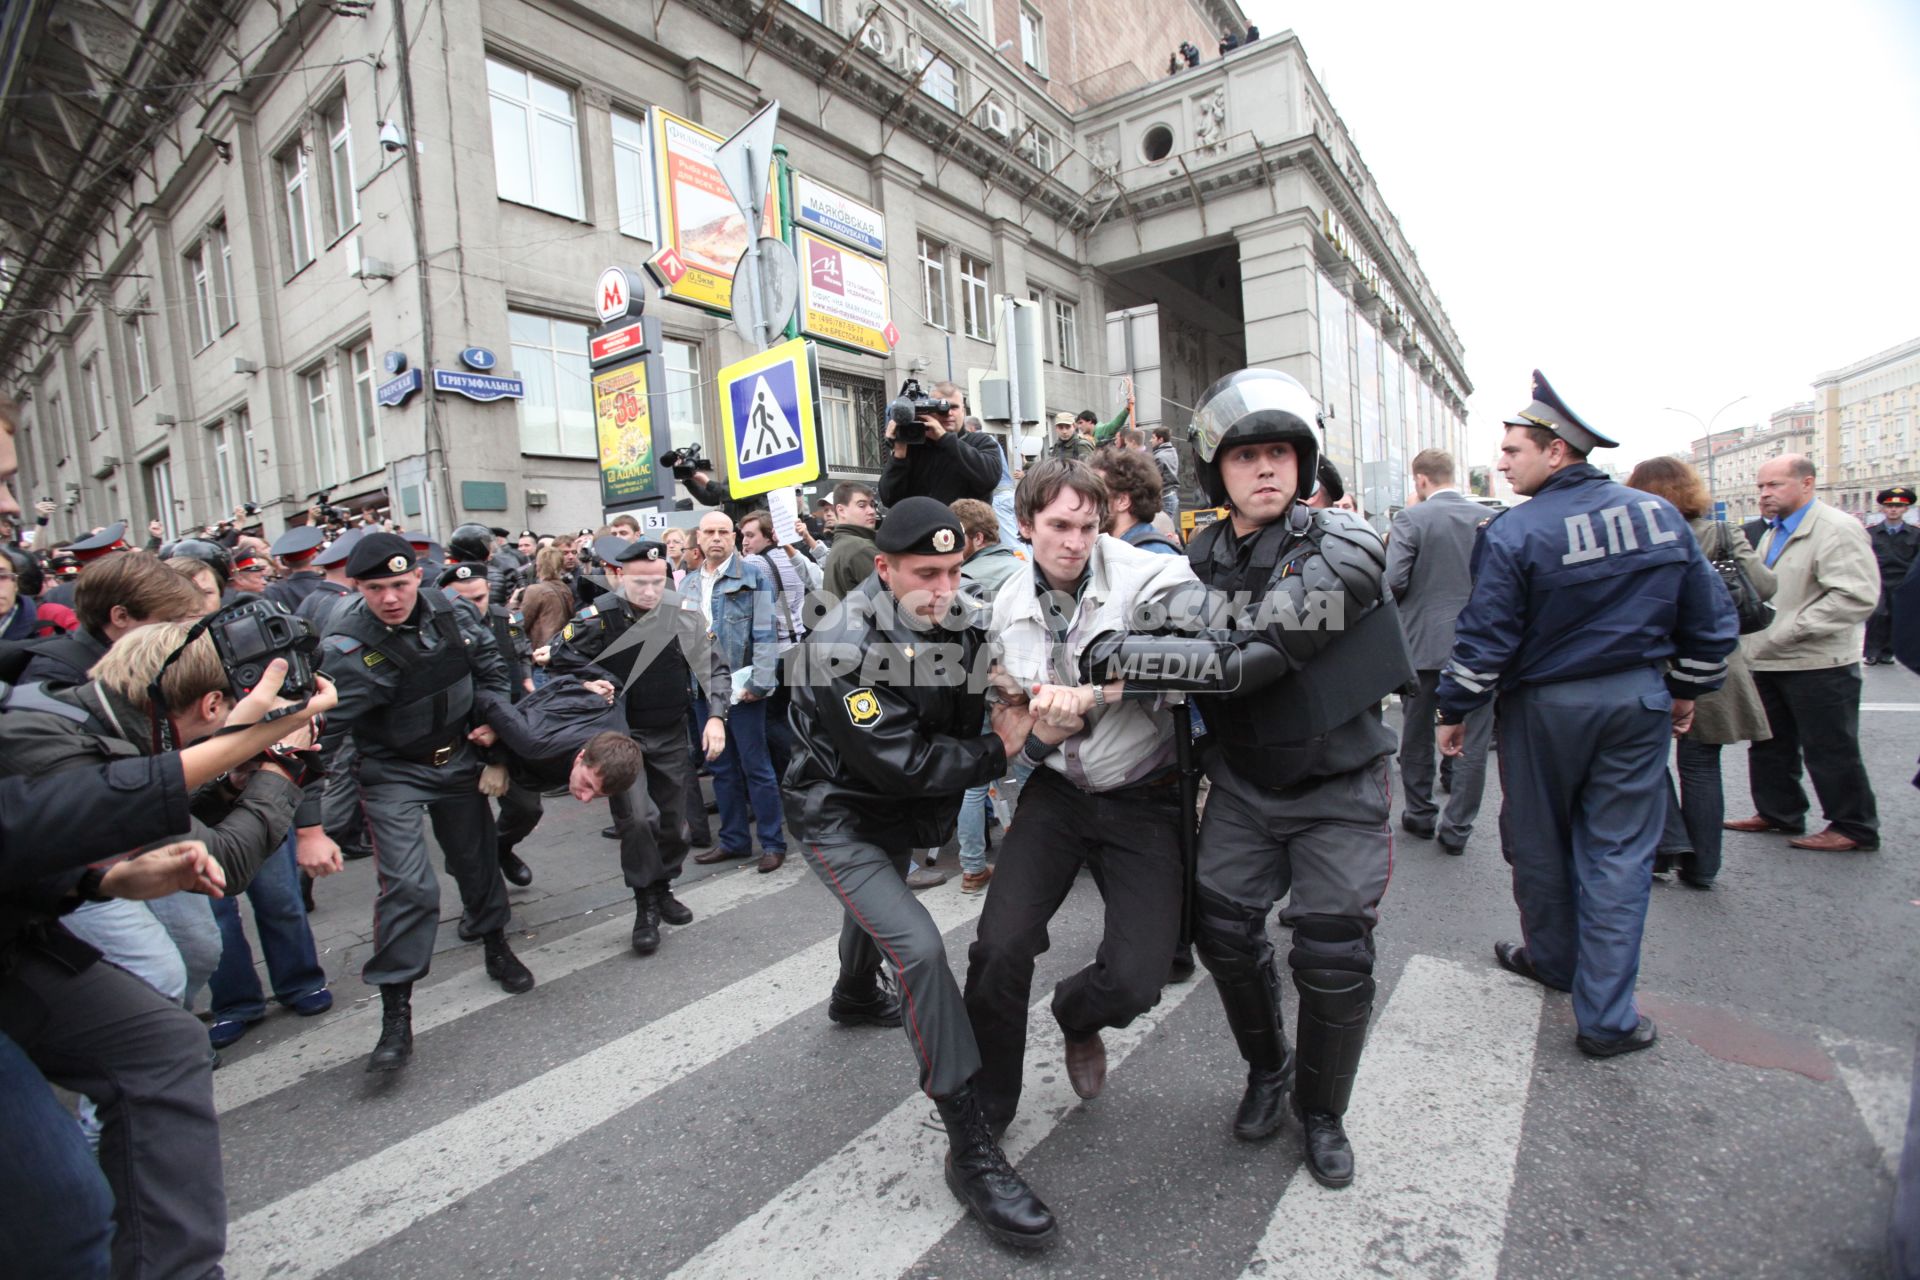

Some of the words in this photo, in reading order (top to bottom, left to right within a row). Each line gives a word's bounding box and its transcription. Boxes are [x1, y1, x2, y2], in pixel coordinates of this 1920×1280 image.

[810, 197, 875, 234] МАЯКОВСКАЯ
[819, 214, 870, 245] MAYAKOVSKAYA
[603, 280, 622, 311] М
[473, 351, 484, 364] 4
[380, 375, 411, 399] ТВЕРСКАЯ
[441, 375, 521, 393] ТРИУМФАЛЬНАЯ
[617, 464, 651, 480] АДАМАС
[1562, 501, 1679, 565] ДПС
